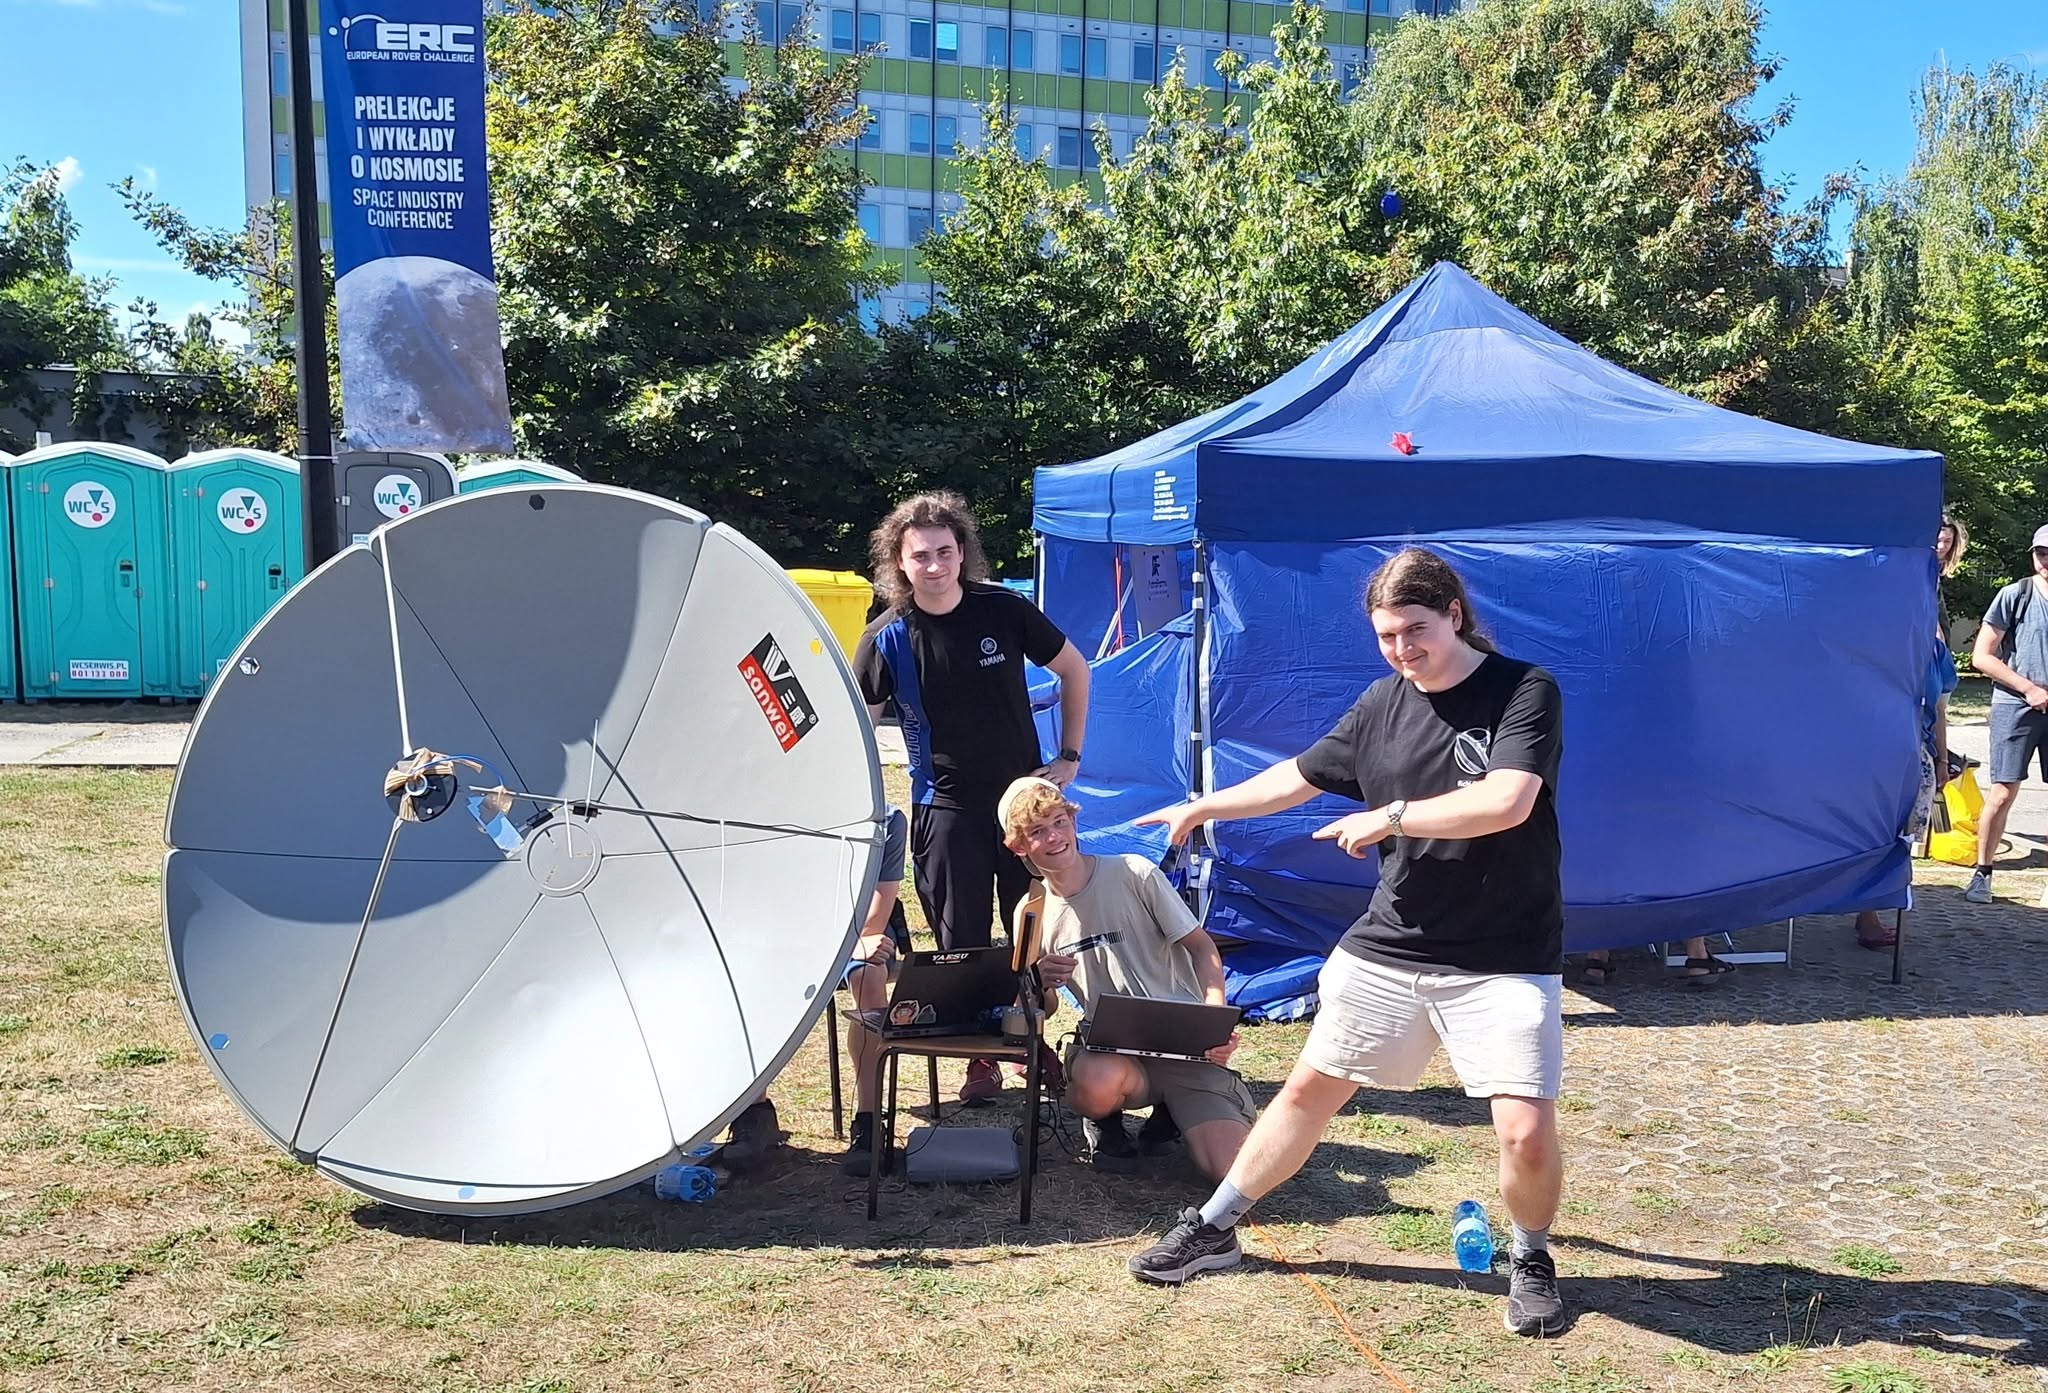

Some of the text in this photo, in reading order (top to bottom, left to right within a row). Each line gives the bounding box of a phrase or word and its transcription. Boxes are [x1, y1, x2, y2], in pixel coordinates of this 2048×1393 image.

[375, 22, 475, 52] ERC
[346, 51, 475, 63] EUROPEAN ROVER CHALLENGE
[355, 96, 455, 121] PRELEKCJE
[356, 126, 455, 152] I WYKŁADY
[351, 155, 464, 182] O KOSMOSIE
[353, 188, 464, 210] SPACE INDUSTRY
[367, 208, 454, 229] CONFERENCE
[979, 653, 1006, 668] YAMAHA
[743, 666, 793, 743] sanwei
[932, 953, 969, 961] YAESU
